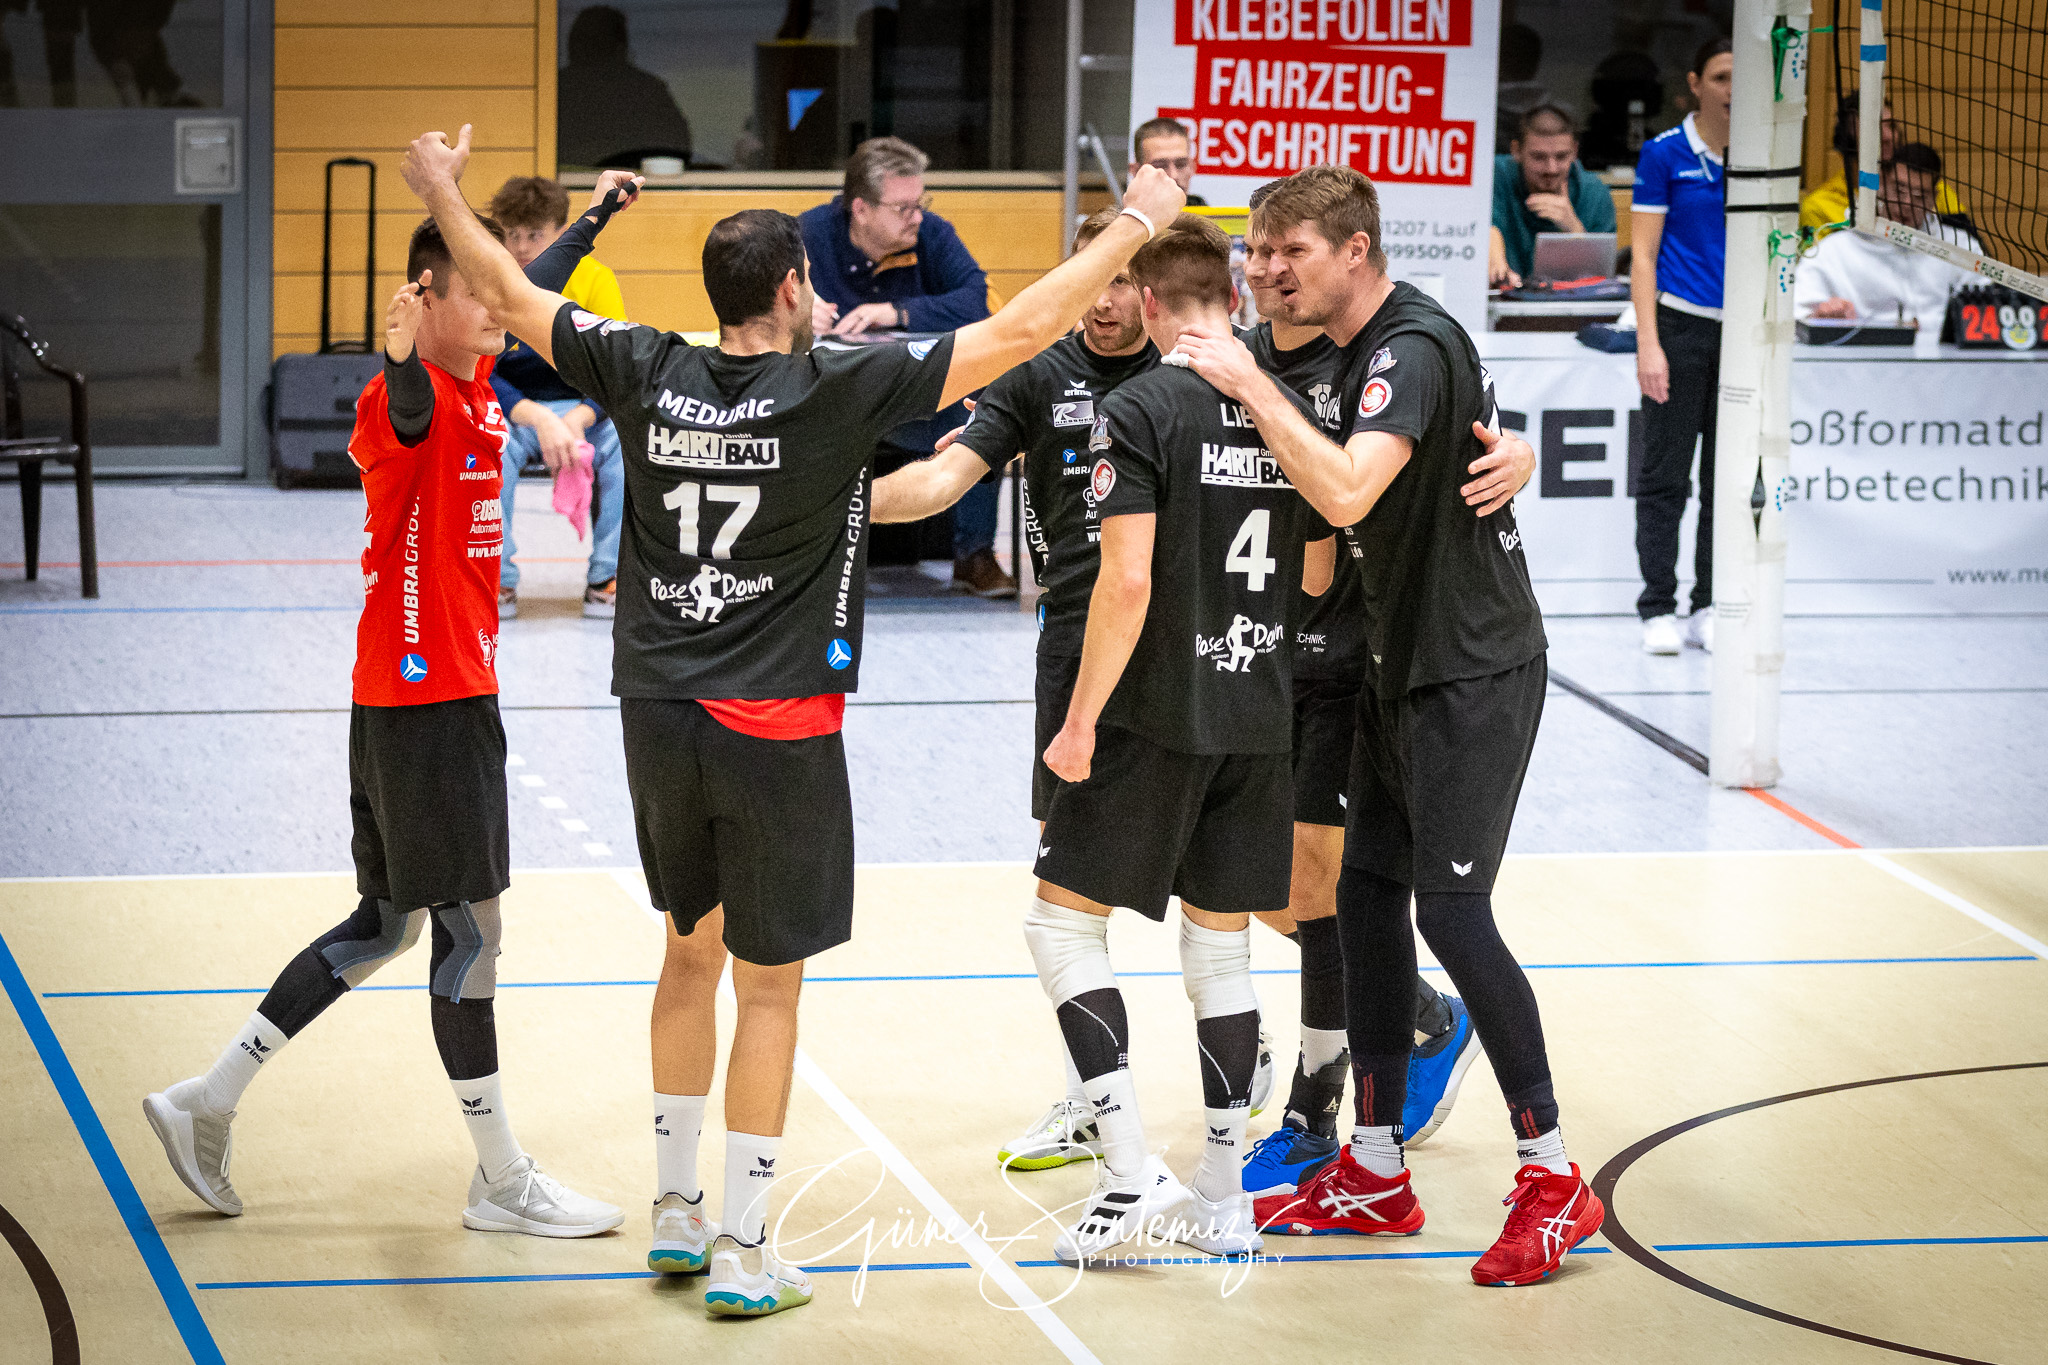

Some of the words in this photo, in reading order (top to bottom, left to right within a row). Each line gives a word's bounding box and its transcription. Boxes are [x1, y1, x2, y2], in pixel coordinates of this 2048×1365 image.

[1191, 0, 1451, 41] KLEBEFOLIEN
[1208, 56, 1437, 114] FAHRZEUG-
[1380, 220, 1427, 236] 1207
[1432, 220, 1476, 237] Lauf
[1962, 304, 2000, 341] 24
[1064, 388, 1093, 397] erima
[657, 388, 775, 426] MEDURIC
[1220, 403, 1257, 429] LIE
[1790, 410, 2044, 446] oßformatd
[648, 422, 724, 460] HART
[725, 441, 776, 466] BAU
[1260, 448, 1275, 458] Gm
[1062, 465, 1092, 477] UMBR
[1201, 442, 1260, 478] HART
[1260, 460, 1295, 486] BA
[1783, 466, 2048, 503] erbetechnik
[662, 481, 761, 560] 17
[1225, 508, 1277, 592] 4
[1499, 528, 1520, 554] Pos
[650, 577, 689, 601] Pose
[722, 573, 774, 599] Down
[1195, 633, 1226, 657] Pose
[240, 1041, 264, 1065] erima
[462, 1108, 493, 1117] erima
[1093, 1103, 1122, 1119] erima
[1207, 1136, 1236, 1148] erima
